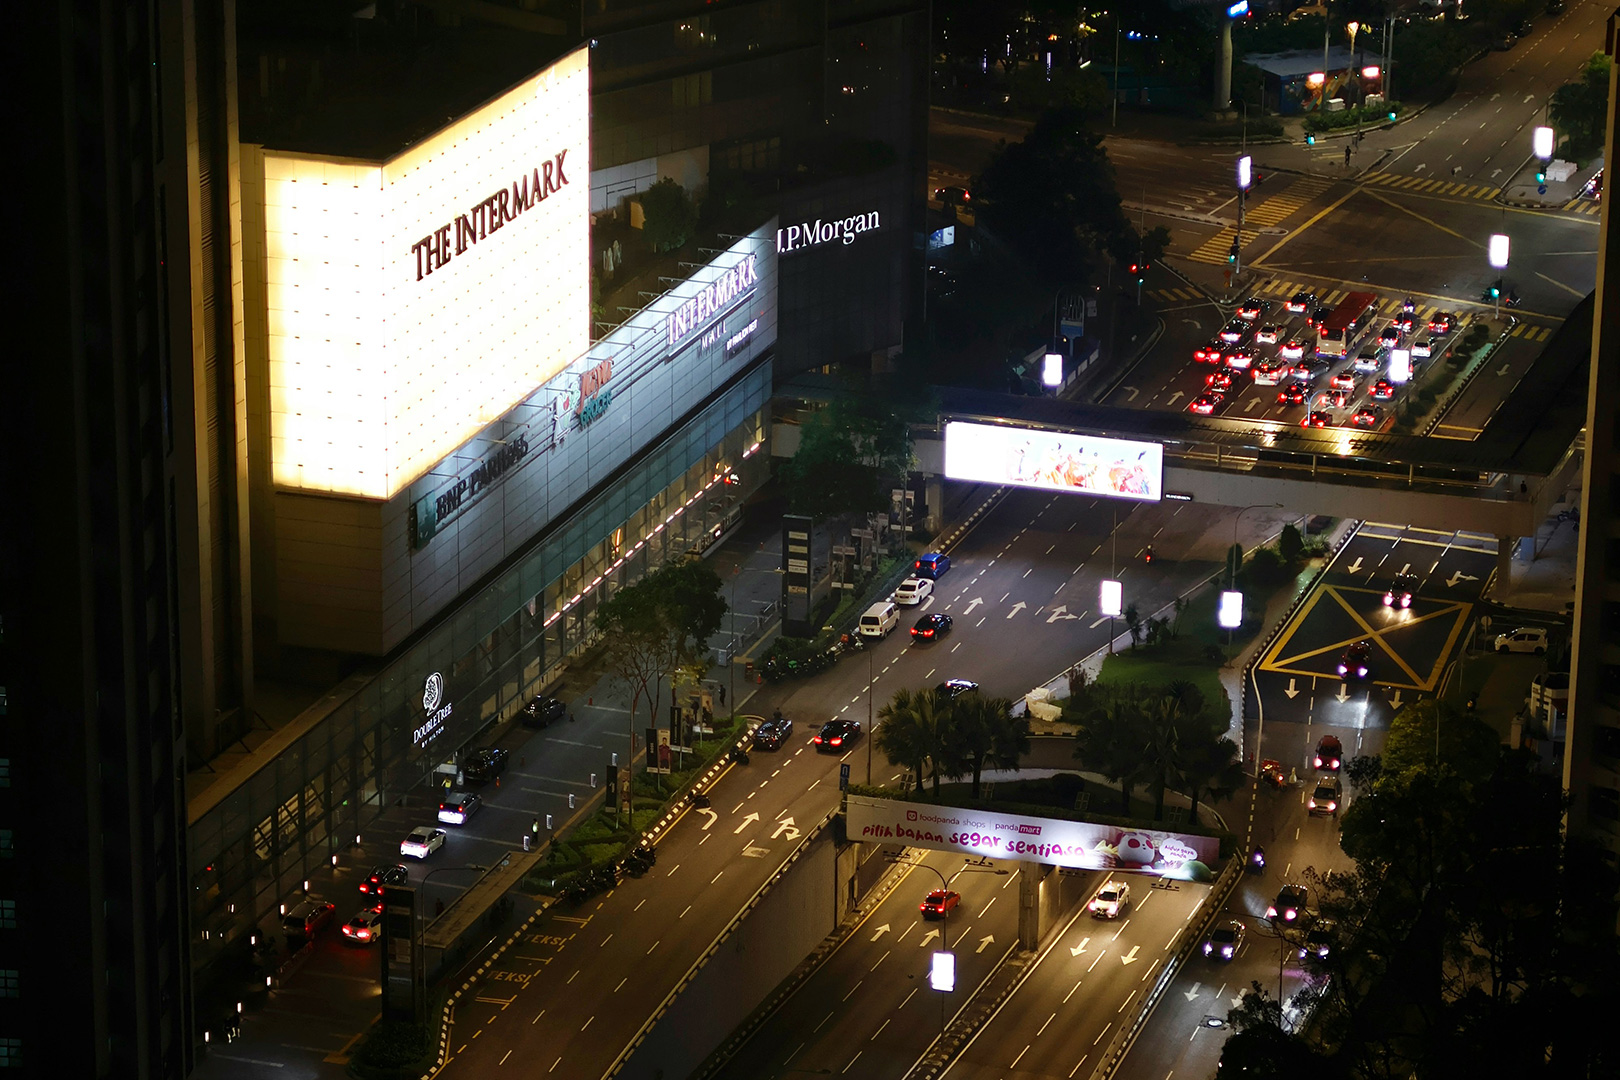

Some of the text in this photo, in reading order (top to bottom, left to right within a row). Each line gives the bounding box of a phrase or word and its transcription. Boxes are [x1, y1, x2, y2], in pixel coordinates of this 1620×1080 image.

[411, 149, 569, 282] THE INTERMARK
[667, 252, 758, 346] INTERMARK
[436, 479, 467, 524] BNP
[919, 813, 960, 826] foodpanda
[962, 818, 986, 829] shops
[862, 824, 893, 838] pilih
[896, 823, 944, 843] bahan
[949, 831, 1001, 847] segar
[523, 933, 568, 946] TEKSI
[486, 970, 532, 983] TEKSI
